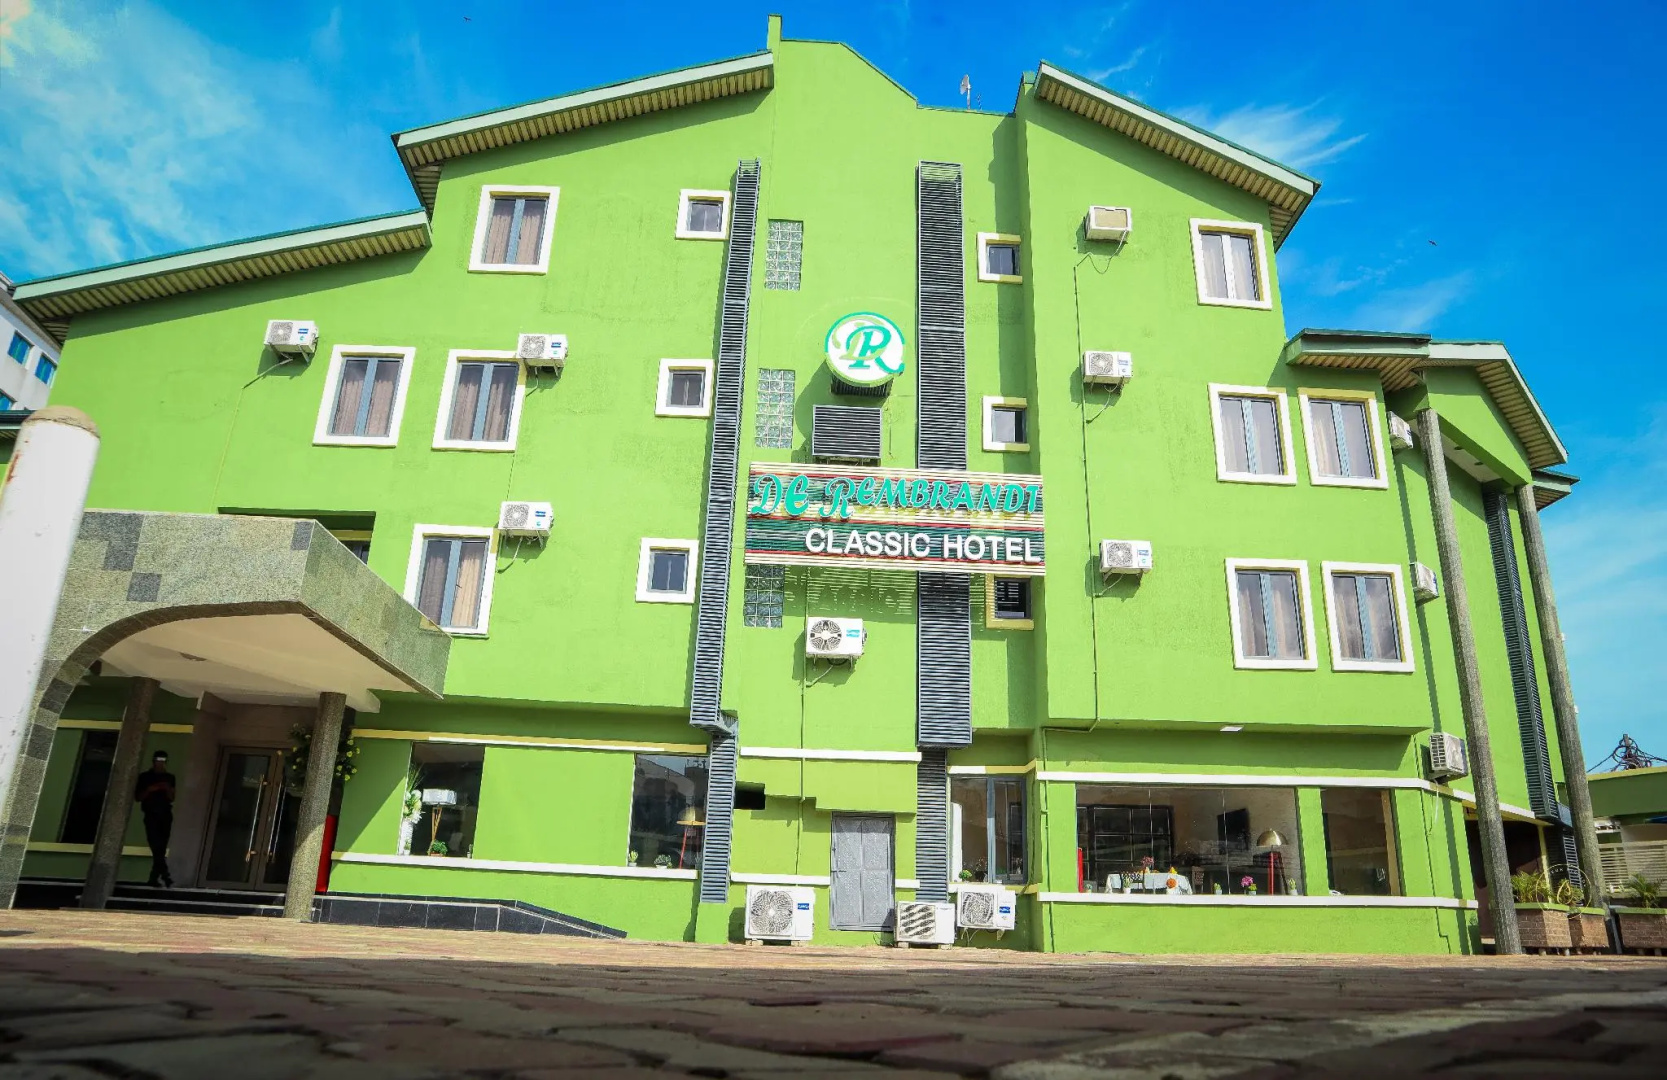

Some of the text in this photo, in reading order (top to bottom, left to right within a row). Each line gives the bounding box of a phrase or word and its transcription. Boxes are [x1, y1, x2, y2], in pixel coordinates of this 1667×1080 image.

[750, 474, 1039, 519] DE REMBRANDT
[805, 527, 1042, 563] CLASSIC HOTEL
